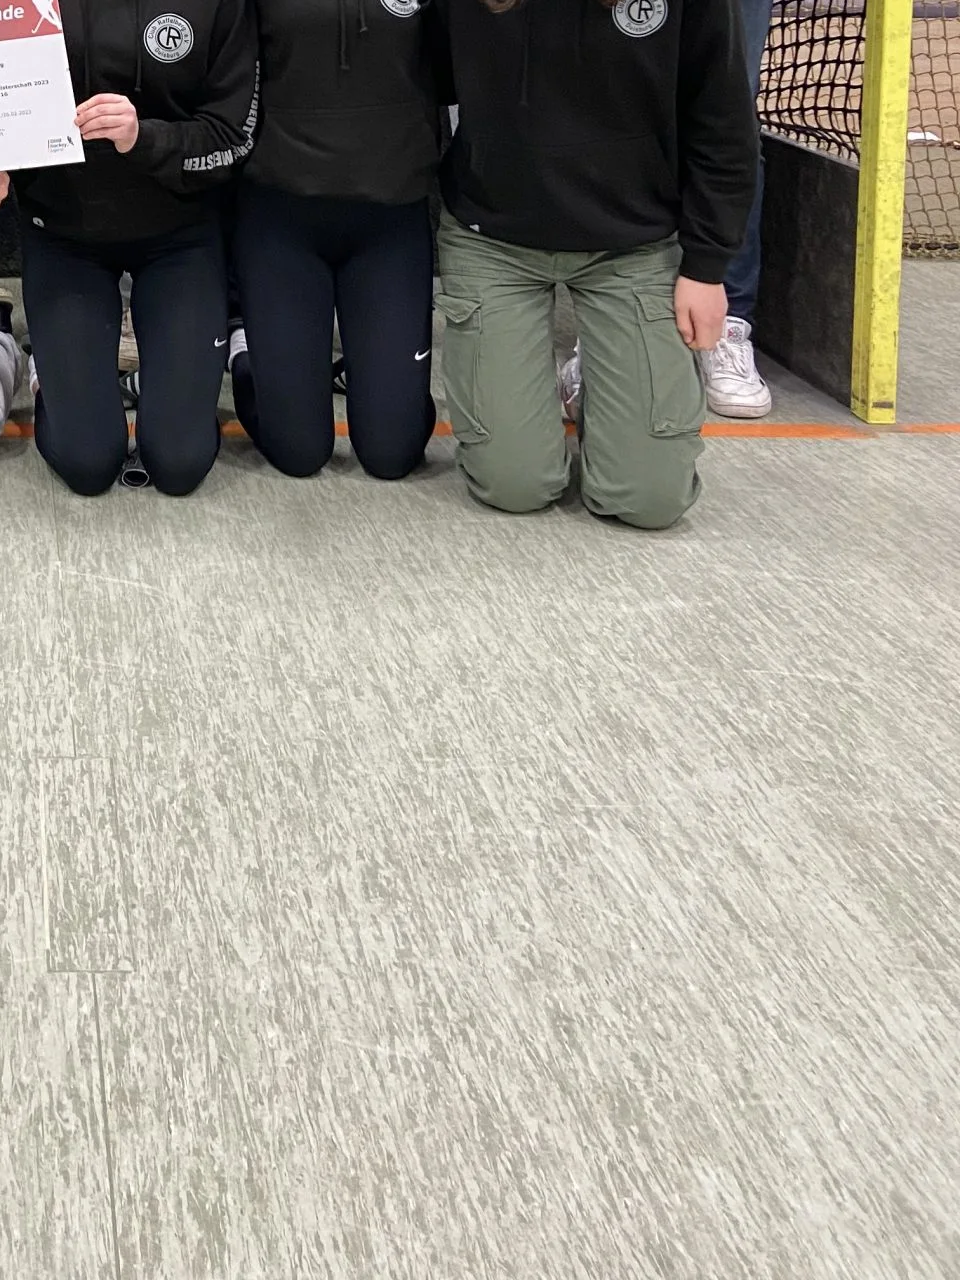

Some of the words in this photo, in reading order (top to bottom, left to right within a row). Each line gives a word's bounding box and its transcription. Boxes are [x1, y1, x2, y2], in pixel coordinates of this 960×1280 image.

[148, 25, 157, 39] Club
[157, 17, 186, 32] Raffelberg
[157, 26, 182, 49] CR
[155, 48, 180, 58] Duisburg
